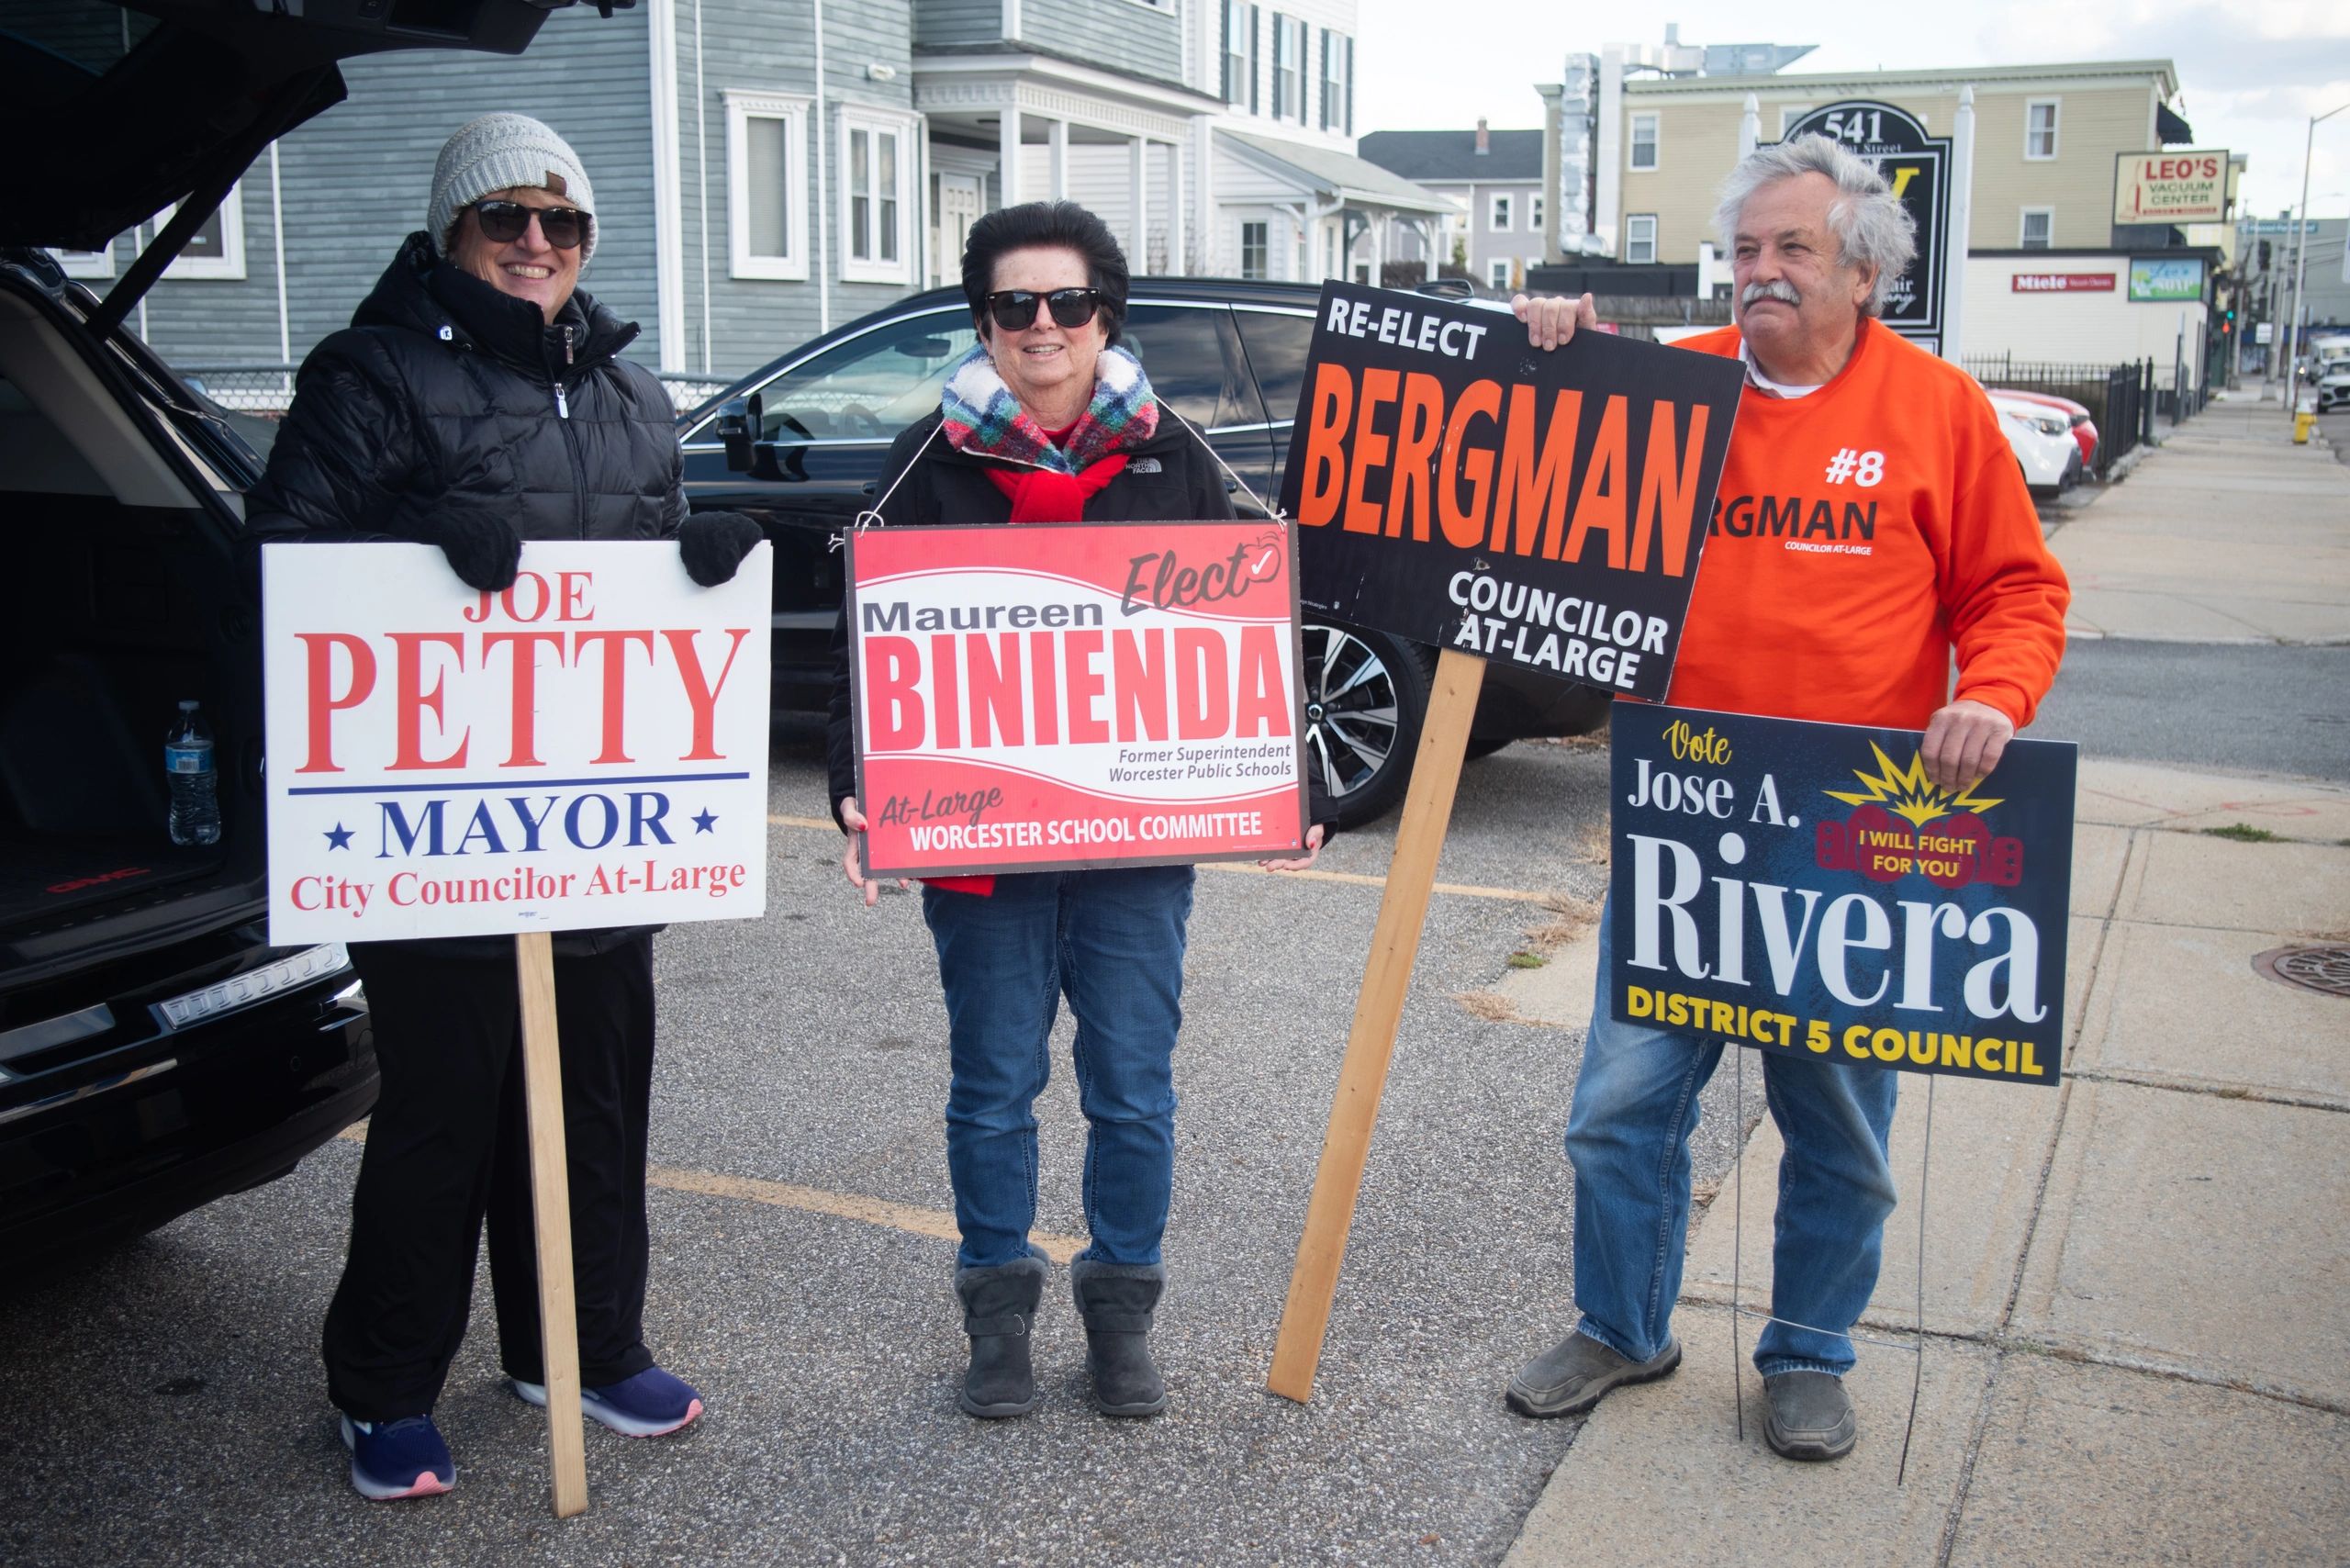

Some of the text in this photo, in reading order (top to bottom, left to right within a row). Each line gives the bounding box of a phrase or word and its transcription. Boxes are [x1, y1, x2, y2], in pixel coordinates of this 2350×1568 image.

[1824, 110, 1883, 143] 541
[1863, 143, 1901, 154] Street
[2146, 158, 2218, 180] LEO'S
[2149, 182, 2214, 193] VACUUM
[2151, 194, 2210, 205] CENTER
[2016, 274, 2067, 290] Miele
[1326, 297, 1487, 360] RE-ELECT
[1298, 363, 1710, 577] BERGMAN
[1825, 448, 1885, 487] #8
[1707, 495, 1877, 541] RGMAN
[1785, 541, 1872, 555] COUNCILOR AT-LARGE
[464, 572, 595, 622] JOE
[1120, 543, 1250, 616] Elect
[863, 602, 1103, 632] Maureen
[1449, 571, 1669, 655] COUNCILOR
[1454, 613, 1640, 689] AT-LARGE
[294, 629, 751, 773] PETTY
[864, 625, 1292, 752] BINIENDA
[1119, 744, 1291, 764] Former Superintendent
[1662, 720, 1732, 766] Vote
[1109, 761, 1292, 782] Worcester Public Schools
[1628, 758, 1800, 828] Jose A.
[375, 791, 676, 858] MAYOR
[878, 787, 1003, 827] At-Large
[910, 812, 1262, 851] WORCESTER SCHOOL COMMITTEE
[1859, 830, 1976, 856] I WILL FIGHT
[290, 859, 745, 917] City Councilor At-Large
[1874, 856, 1958, 878] FOR YOU
[1627, 832, 2047, 1023] Rivera
[1628, 986, 2044, 1076] DISTRICT 5 COUNCIL
